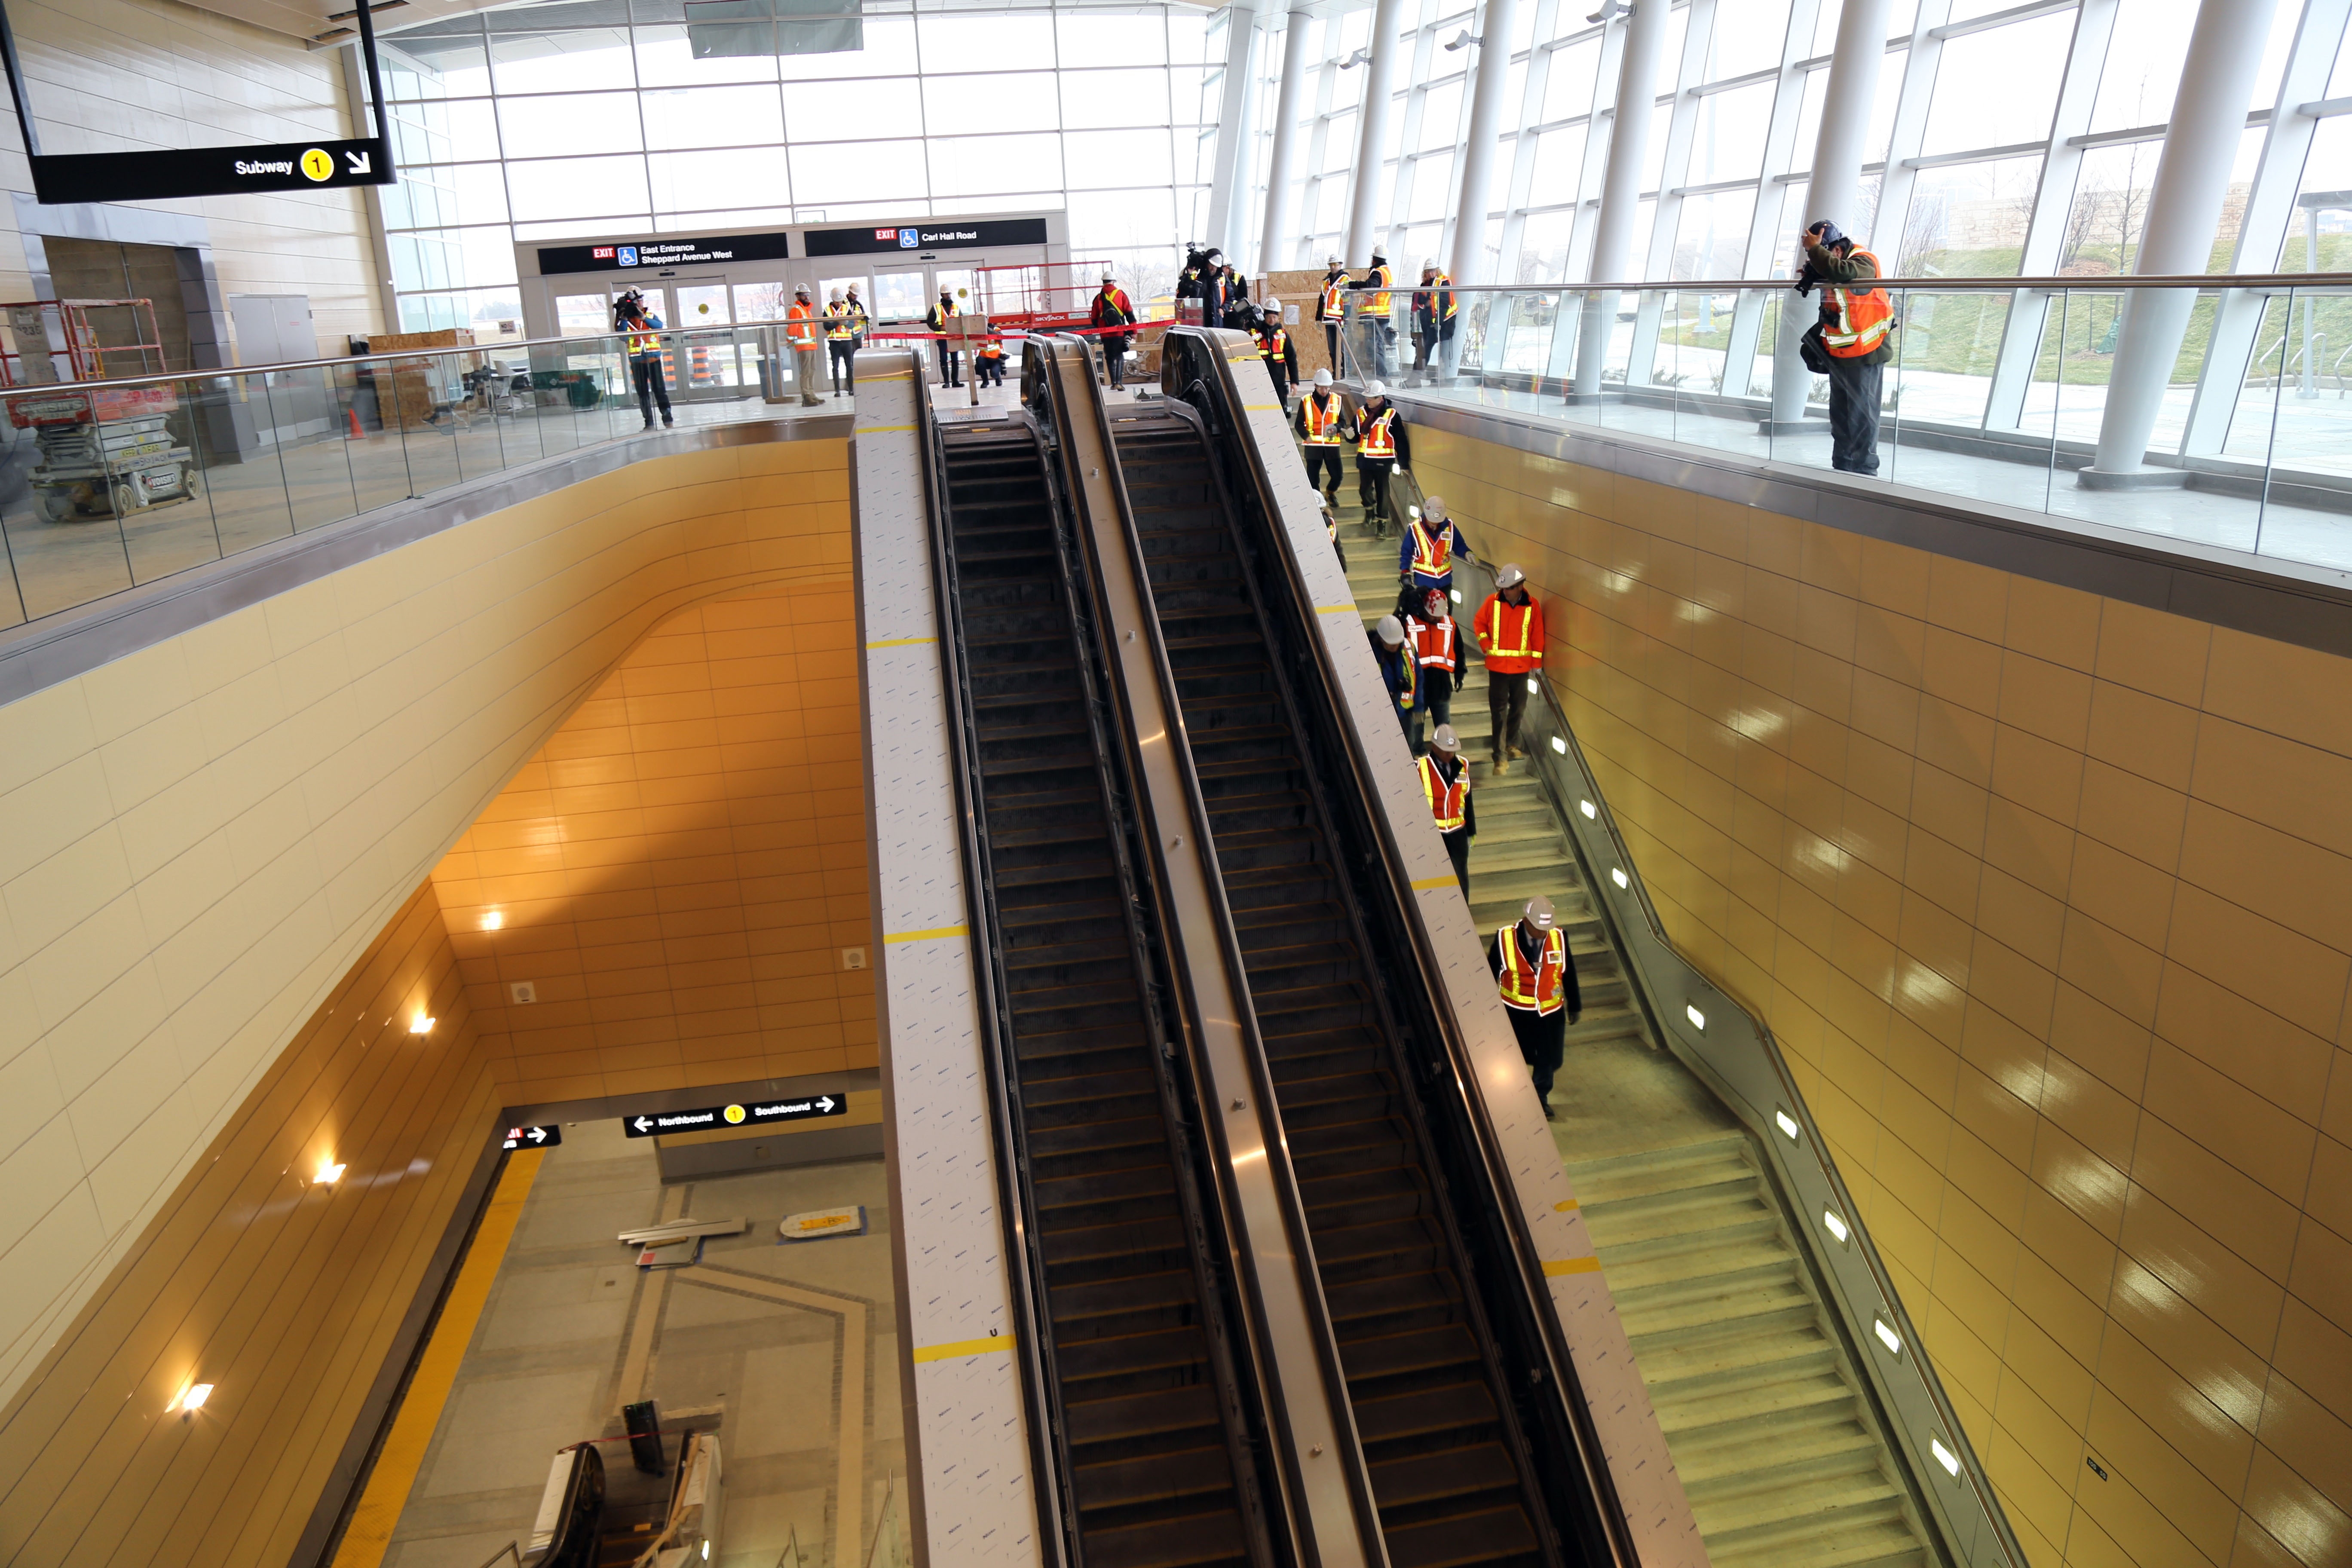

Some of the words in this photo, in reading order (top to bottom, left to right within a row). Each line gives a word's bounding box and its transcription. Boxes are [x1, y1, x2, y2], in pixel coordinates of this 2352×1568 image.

[235, 160, 293, 175] Subway
[312, 157, 320, 173] 1
[876, 230, 895, 239] EXIT
[922, 233, 938, 241] Carl
[940, 232, 955, 240] Hall
[956, 231, 977, 239] Road
[594, 248, 613, 257] EXIT
[640, 246, 658, 254] East
[660, 245, 695, 253] Entrance
[642, 254, 680, 264] Sheppard
[682, 253, 711, 261] Avenue
[712, 251, 732, 259] West
[658, 1113, 713, 1126] Northbound
[732, 1110, 737, 1118] 1
[755, 1102, 811, 1116] Southbound
[2089, 1459, 2097, 1470] 10S
